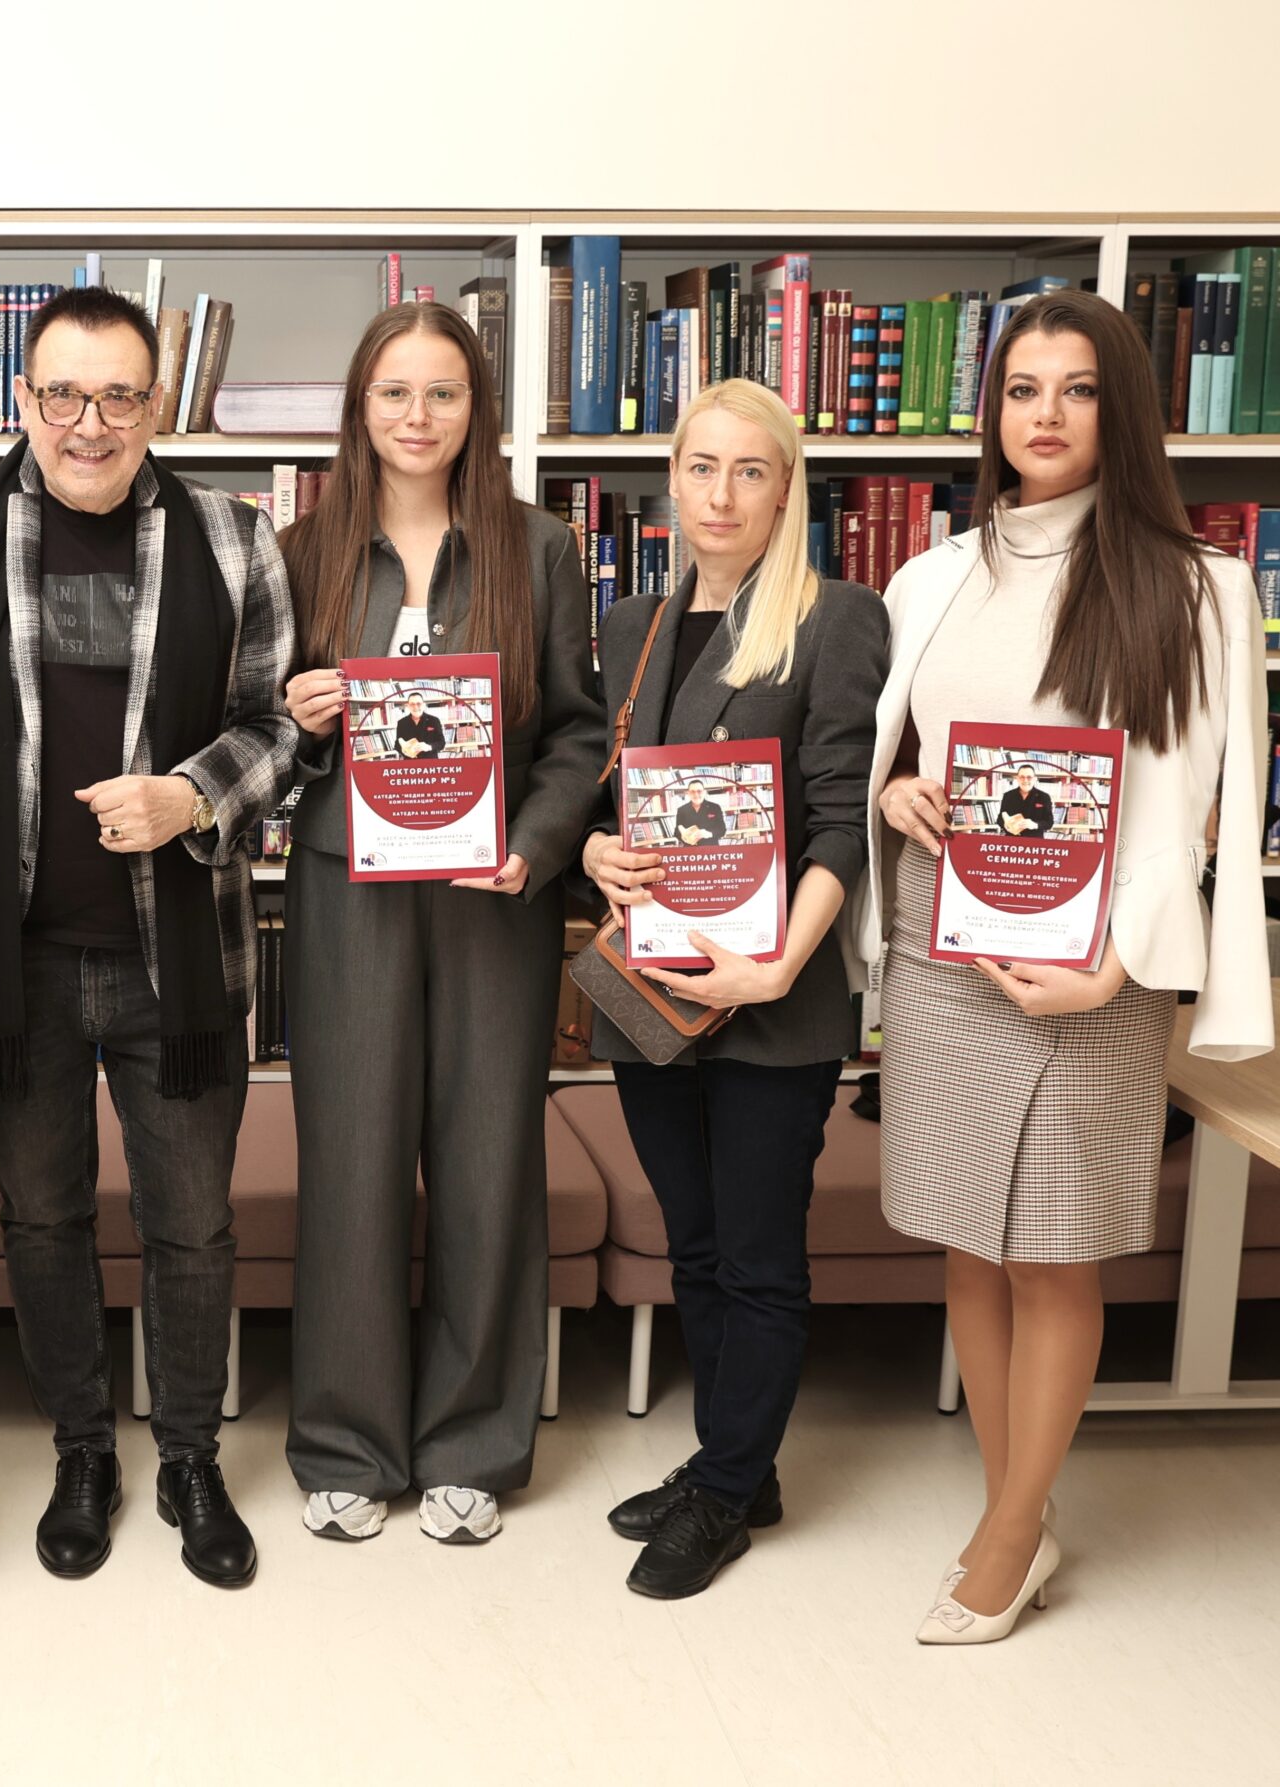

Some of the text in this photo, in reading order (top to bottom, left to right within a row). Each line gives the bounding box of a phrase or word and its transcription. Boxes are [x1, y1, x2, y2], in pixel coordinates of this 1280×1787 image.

[390, 261, 398, 304] LAROUSSE
[791, 290, 802, 409] БОЛЬШАЯ КНИГА ПО ЭКОНОМИКЕ
[194, 327, 218, 424] MASS MEDIA DICTIONARY
[663, 355, 674, 402] Handbook
[281, 490, 290, 524] ССИЯ
[590, 532, 599, 584] ДВОЙКИ
[399, 635, 431, 656] alo
[383, 766, 461, 776] ДОКТОРАНТСКИ
[390, 777, 436, 785] СЕМИНАР
[662, 852, 743, 862] ДОКТОРАНТСКИ
[980, 843, 1068, 857] ДОКТОРАНТСКИ
[986, 855, 1038, 865] СЕМИНАР
[669, 864, 716, 872] СЕМИНАР
